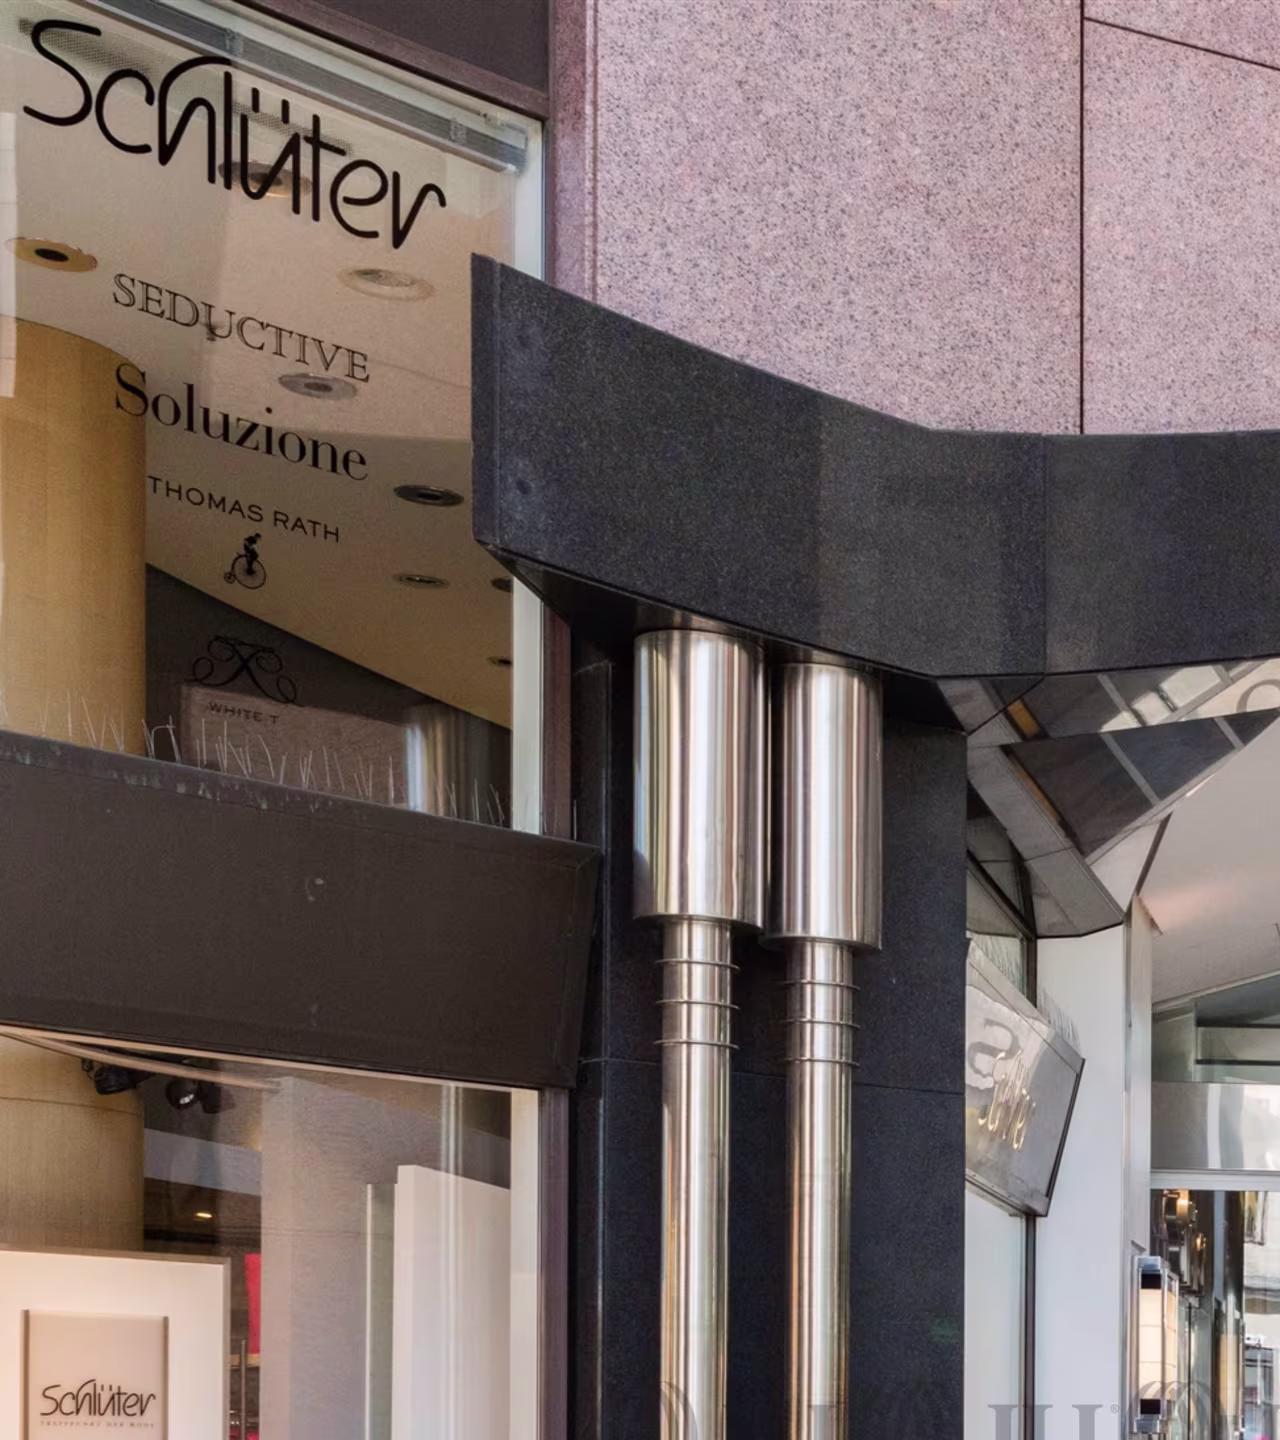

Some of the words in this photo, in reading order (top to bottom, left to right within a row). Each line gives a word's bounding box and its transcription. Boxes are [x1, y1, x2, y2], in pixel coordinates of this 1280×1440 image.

[22, 19, 448, 250] Schlüter
[112, 272, 370, 383] SEDUCTIVE
[115, 362, 369, 481] Soluzione
[147, 475, 264, 523] THOMAS
[273, 509, 340, 543] RATH
[207, 701, 263, 723] WHITE
[40, 1379, 157, 1417] Schlüter
